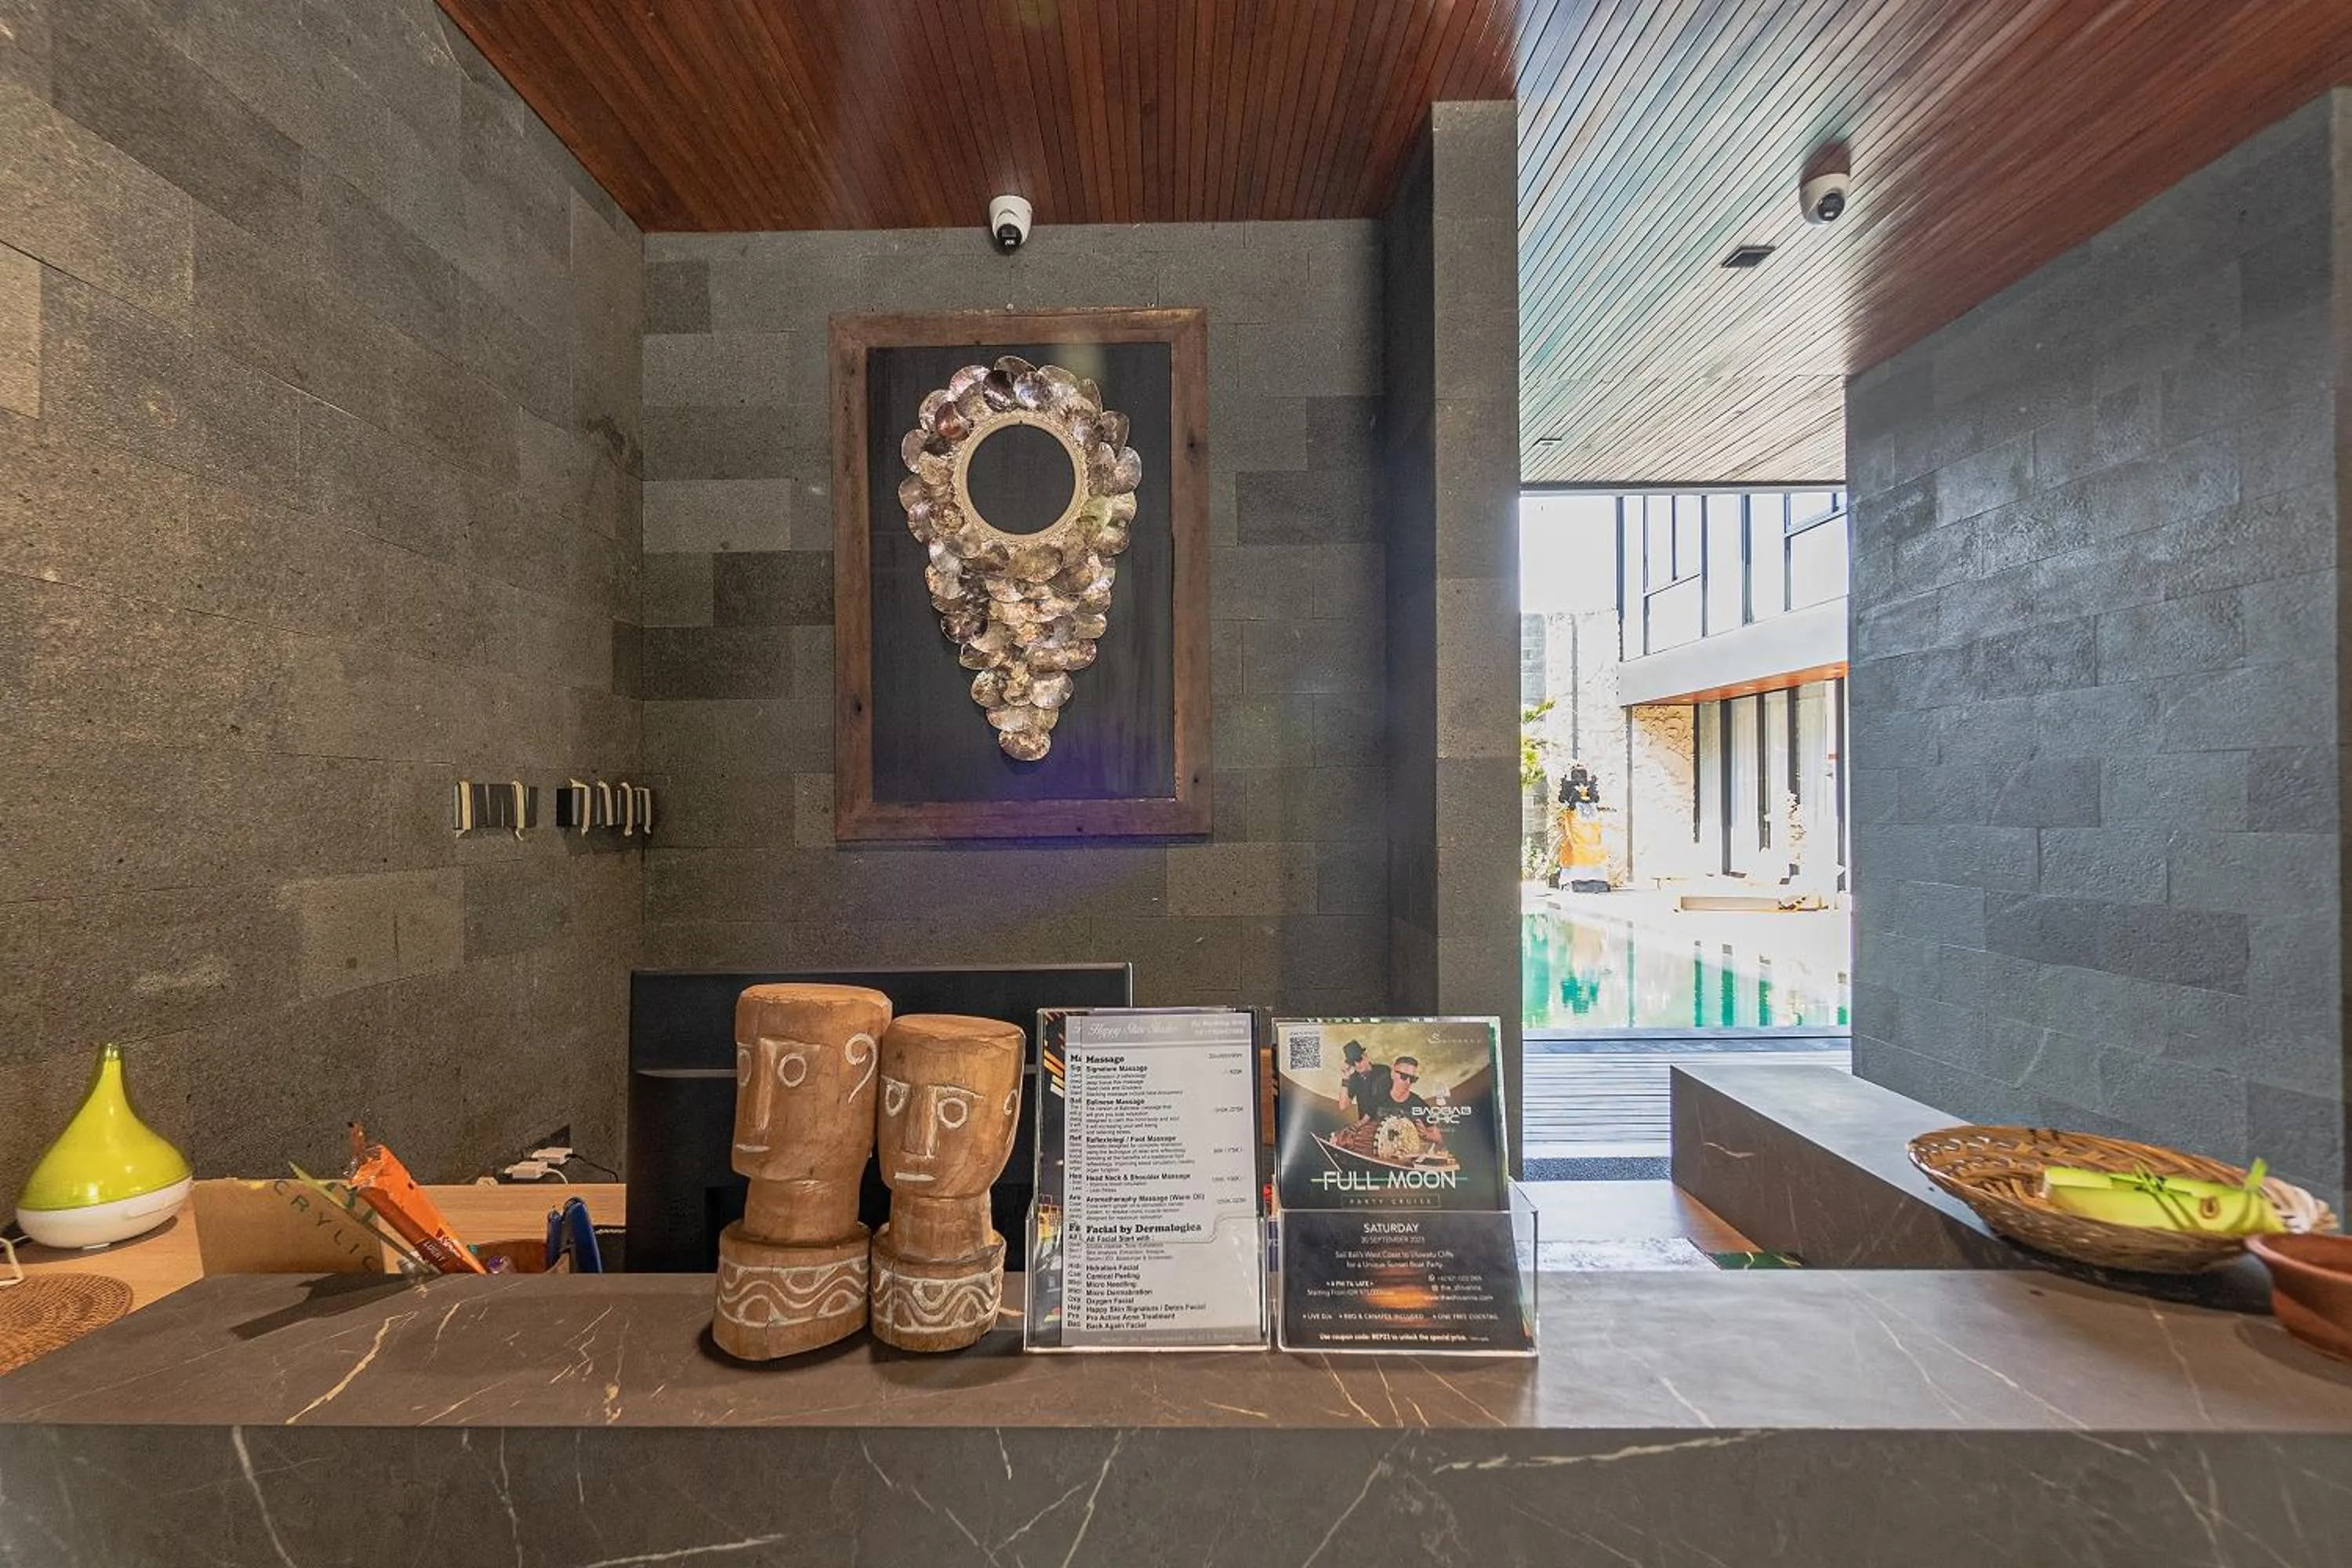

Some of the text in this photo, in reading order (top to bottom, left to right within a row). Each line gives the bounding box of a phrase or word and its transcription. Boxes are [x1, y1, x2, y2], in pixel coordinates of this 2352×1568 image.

[1086, 1054, 1125, 1065] Massage
[1412, 1106, 1472, 1116] BAOBAB
[1426, 1115, 1461, 1124] CHIC
[1323, 1170, 1457, 1191] FULL MOON
[1086, 1225, 1117, 1234] Facial
[1120, 1224, 1133, 1236] by
[1134, 1222, 1202, 1233] Dermalogica
[1363, 1223, 1419, 1233] SATURDAY
